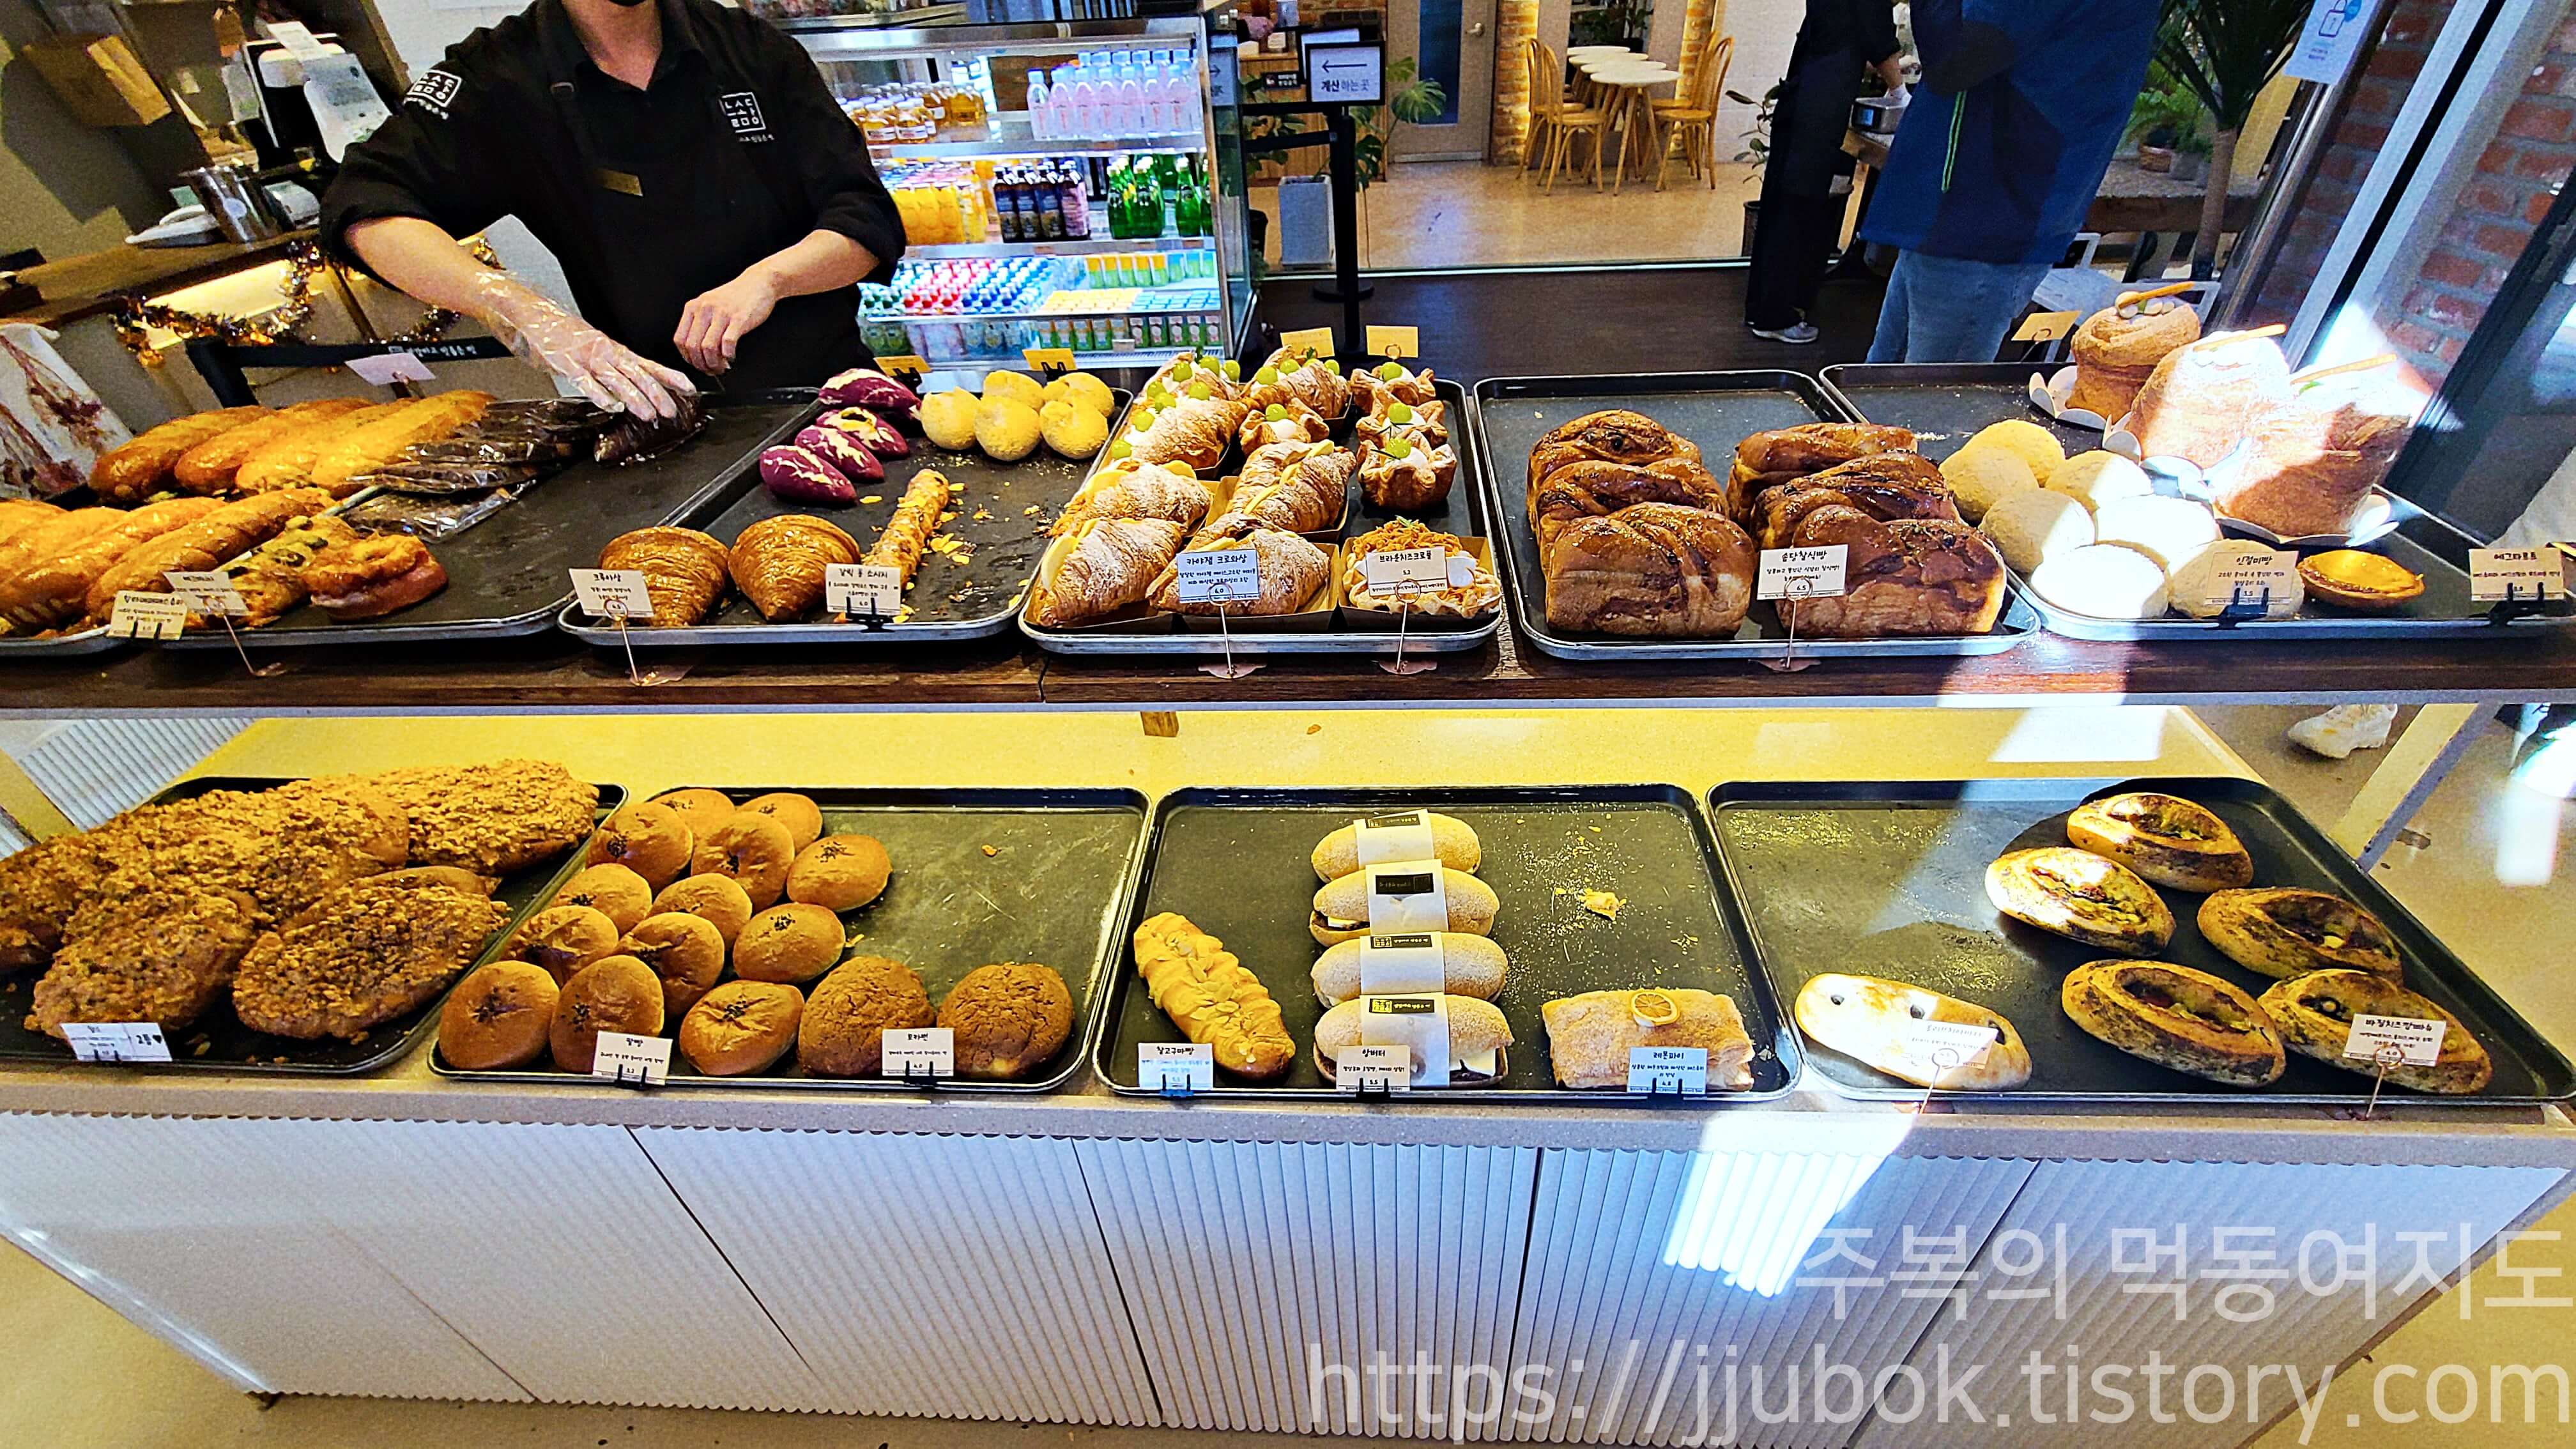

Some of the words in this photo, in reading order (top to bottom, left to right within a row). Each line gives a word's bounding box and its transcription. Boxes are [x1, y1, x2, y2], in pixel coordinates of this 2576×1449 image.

[1186, 556, 1213, 566] 카야잼
[1217, 553, 1248, 564] 크로와상
[1379, 549, 1432, 563] 브라운치즈크로플
[2237, 555, 2273, 565] 인절미빵
[1156, 1046, 1195, 1055] 찰고구마빵
[1362, 1048, 1386, 1058] 앙버터
[1653, 1051, 1684, 1060] 레몬파이
